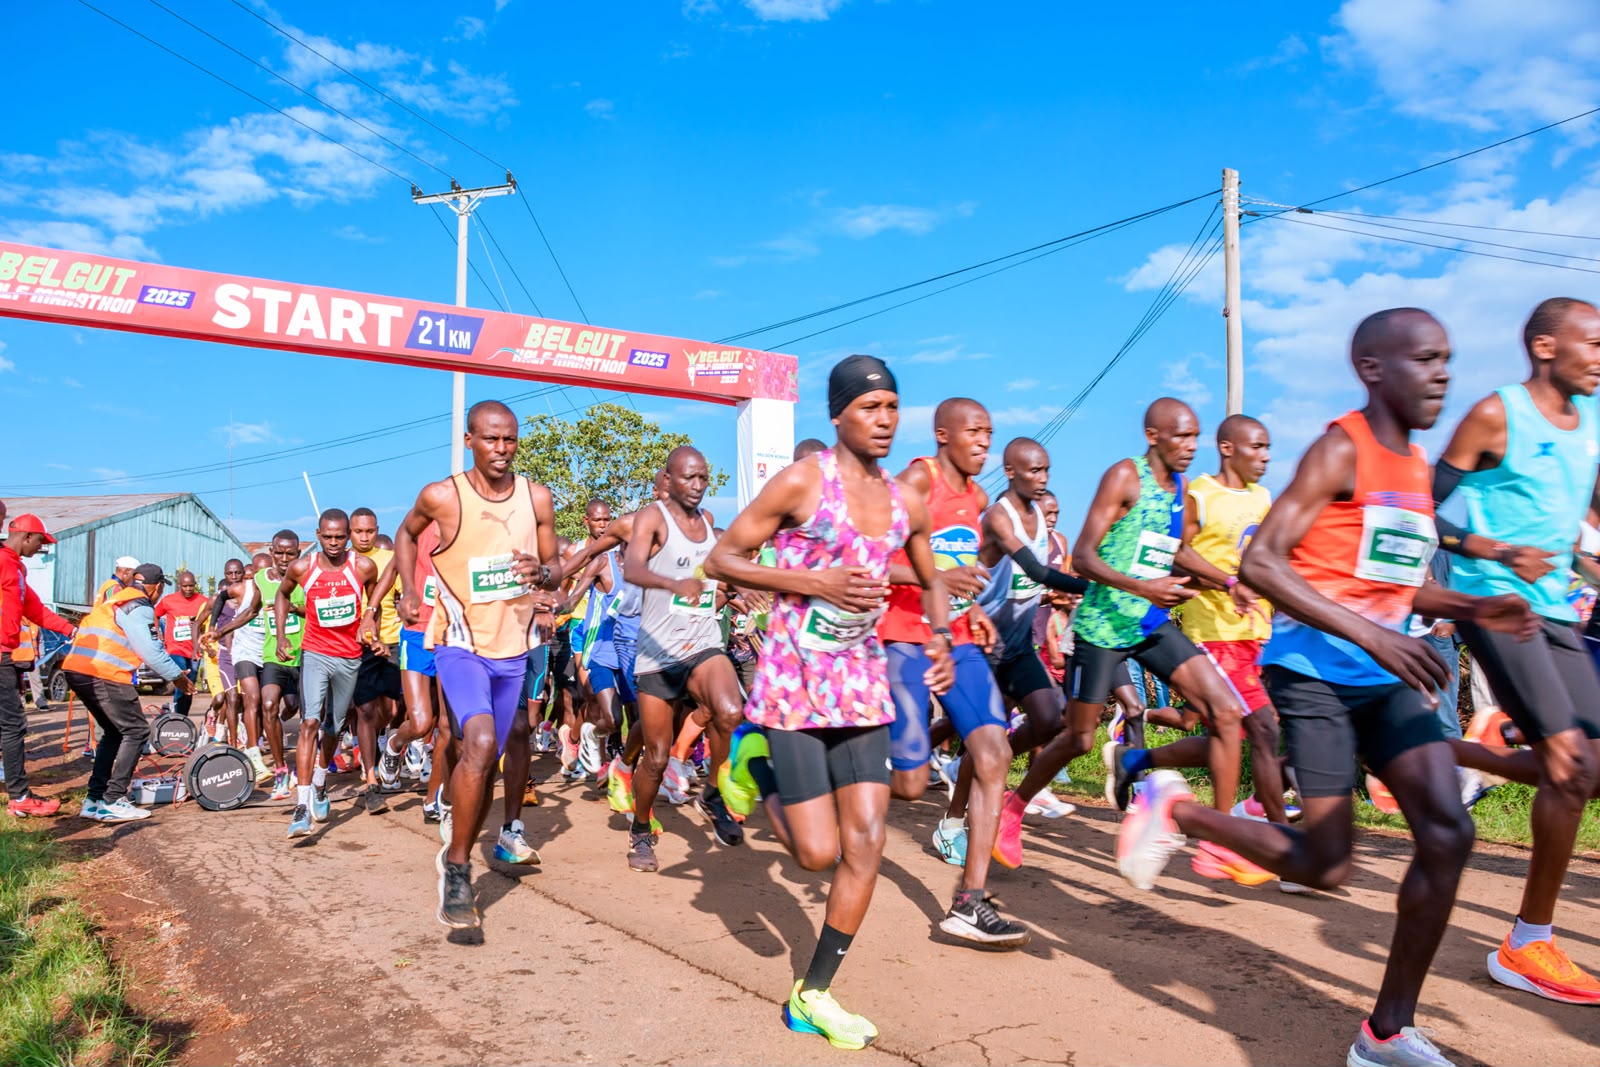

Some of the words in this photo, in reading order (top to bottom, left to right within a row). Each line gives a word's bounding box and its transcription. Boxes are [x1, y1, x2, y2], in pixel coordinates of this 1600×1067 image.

[0, 252, 136, 295] BELGUT
[143, 288, 191, 307] 2025
[211, 283, 403, 347] START
[523, 323, 626, 358] BELGUT
[632, 351, 666, 367] 2025
[699, 350, 742, 363] BELGUT
[321, 605, 352, 618] 21329
[201, 768, 243, 787] MYLAPS
